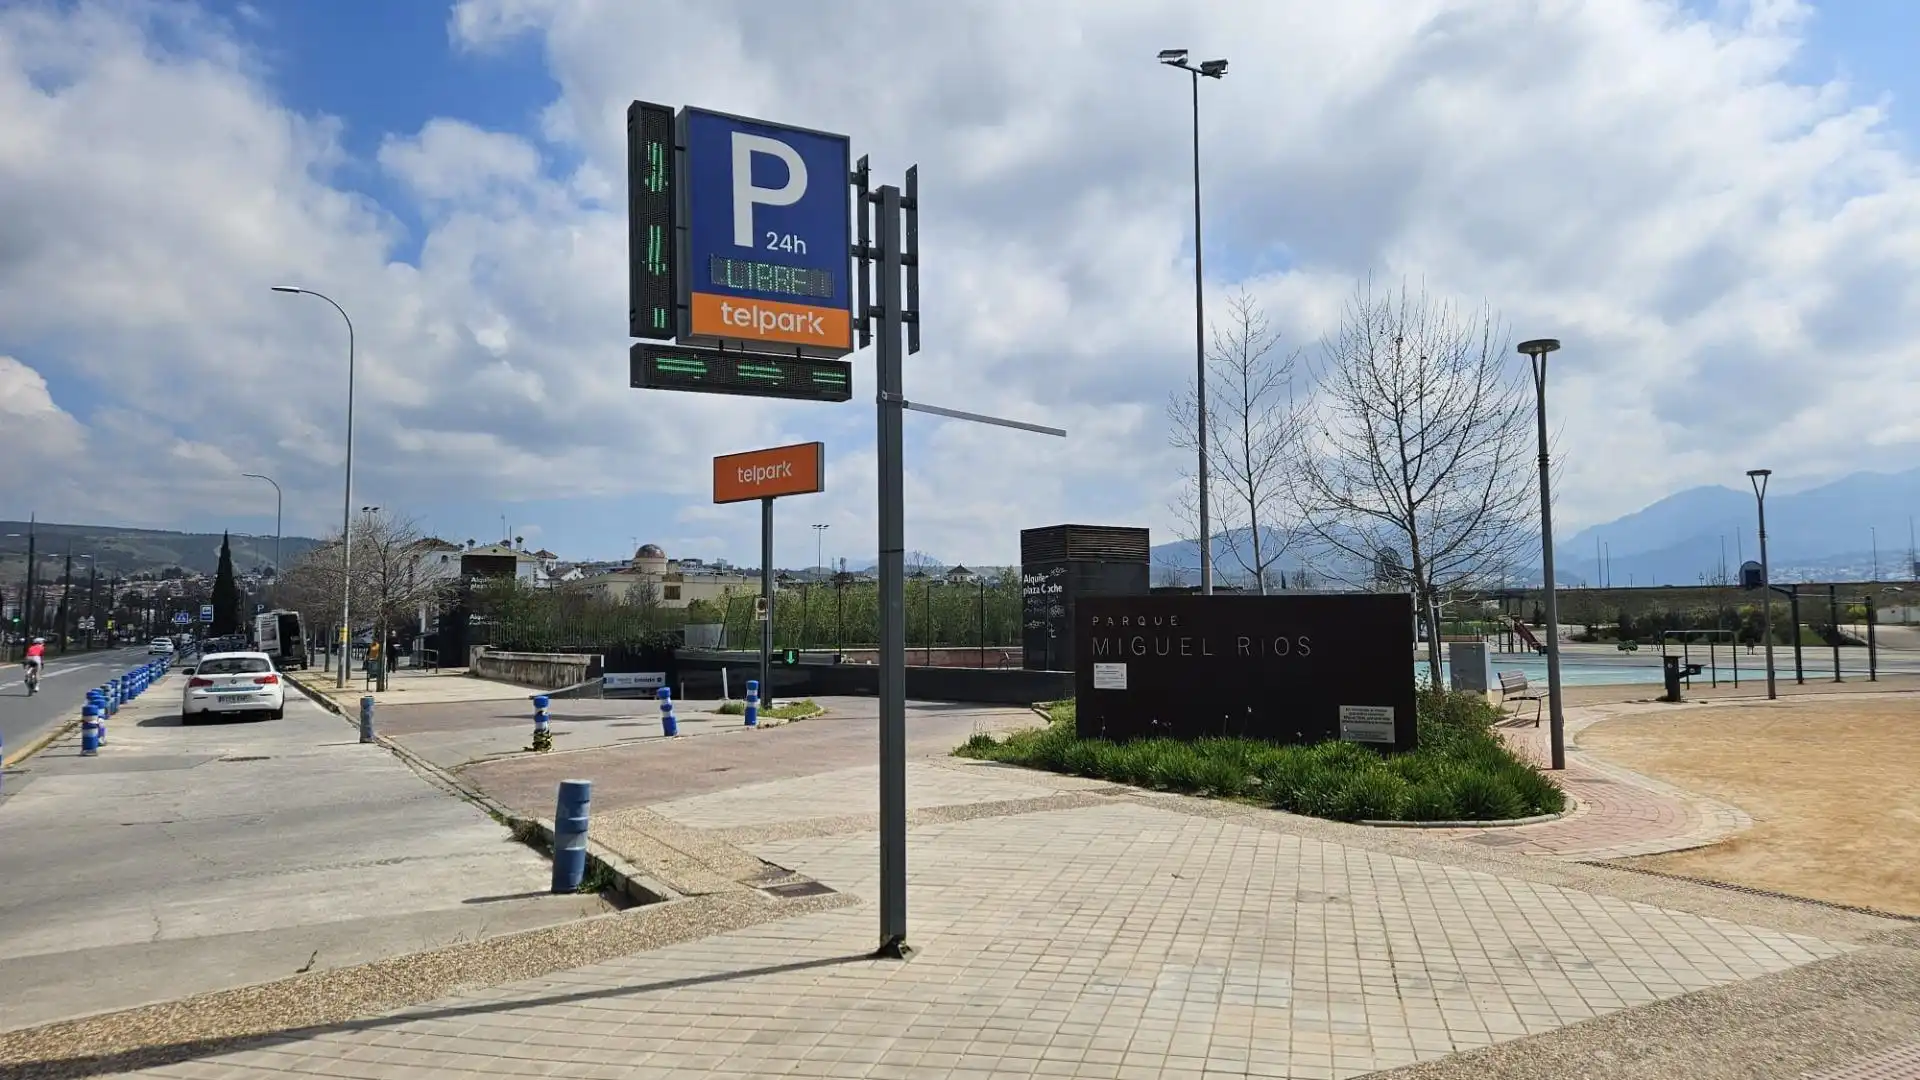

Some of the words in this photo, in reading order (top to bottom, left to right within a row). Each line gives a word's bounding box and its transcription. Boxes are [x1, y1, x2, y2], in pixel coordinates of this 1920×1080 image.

[731, 131, 808, 248] P
[766, 231, 807, 254] 24h
[727, 259, 807, 296] LIBRE
[720, 301, 825, 335] telpark
[737, 460, 792, 485] telpark
[1092, 615, 1178, 627] PARQUE
[1092, 635, 1215, 657] MIGUEL
[1237, 635, 1312, 657] RIOS
